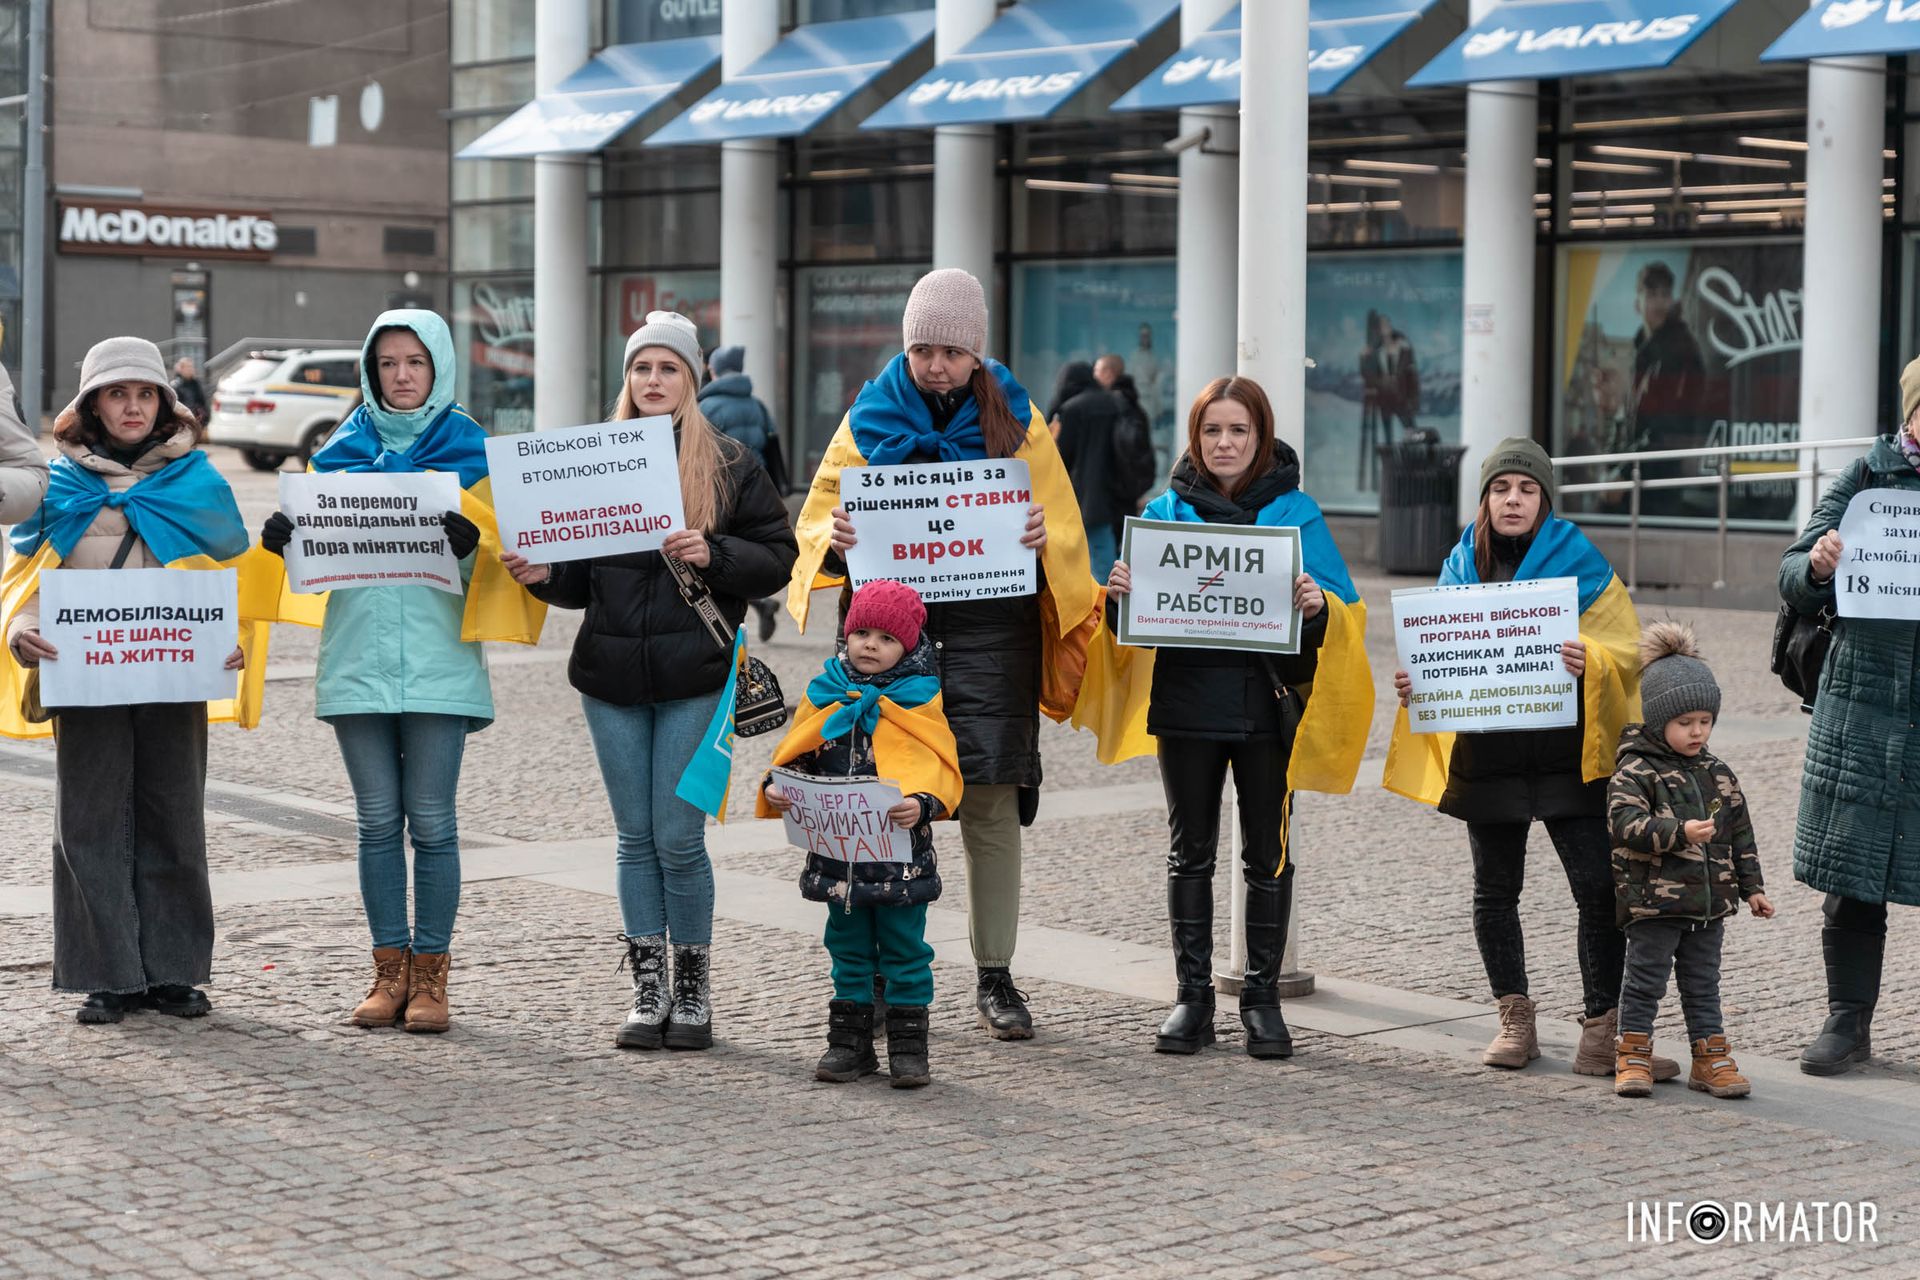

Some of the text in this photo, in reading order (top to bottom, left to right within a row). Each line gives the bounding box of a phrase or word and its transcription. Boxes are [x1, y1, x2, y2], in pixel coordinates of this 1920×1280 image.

[1516, 14, 1700, 53] VARUS
[946, 71, 1082, 103] VARUS
[722, 90, 844, 121] VARUS
[60, 206, 278, 250] McDonald's
[517, 430, 645, 457] Військові теж
[522, 457, 648, 484] втомлюються
[861, 467, 1006, 487] 36 місяців за
[317, 493, 418, 511] За перемогу
[844, 489, 1030, 514] рішенням ставки
[296, 513, 444, 529] відповідальні всі
[541, 502, 643, 525] Вимагаємо
[517, 514, 672, 549] ДЕМОБІЛІЗАЦІЮ
[928, 518, 955, 534] це
[302, 538, 445, 557] Пора мінятися!
[892, 538, 984, 564] вирок
[1158, 543, 1264, 574] АРМІЯ
[931, 568, 1025, 583] встановлення
[1845, 574, 1870, 594] 18
[976, 583, 1026, 597] служби
[701, 602, 717, 623] DIOR
[1157, 592, 1265, 616] РАБСТВО
[56, 606, 224, 625] ДЕМОБІЛІЗАЦІЯ
[1137, 615, 1283, 631] Вимагаємо термінів служби!
[1403, 612, 1484, 628] ВИСНАЖЕНІ
[1490, 606, 1561, 622] ВІЙСЬКОВІ
[97, 629, 124, 645] ЦЕ
[130, 627, 193, 642] ШАНС
[1420, 625, 1541, 644] ПРОГРАНА ВІЙНА!
[86, 648, 194, 665] НА ЖИТТЯ
[1411, 643, 1562, 664] ЗАХИСНИКАМ ДАВНО
[1422, 661, 1554, 680] ПОТРІБНА ЗАМІНА!
[1410, 682, 1573, 704] НЕГАЙНА ДЕМОБІЛІЗАЦІЯ
[1418, 701, 1563, 721] БЕЗ РІШЕННЯ СТАВКИ!
[782, 784, 869, 810] МОЯ ЧЕРГА
[789, 803, 894, 836] ОБІЙМАТИ
[801, 827, 893, 862] ТАТА!!!
